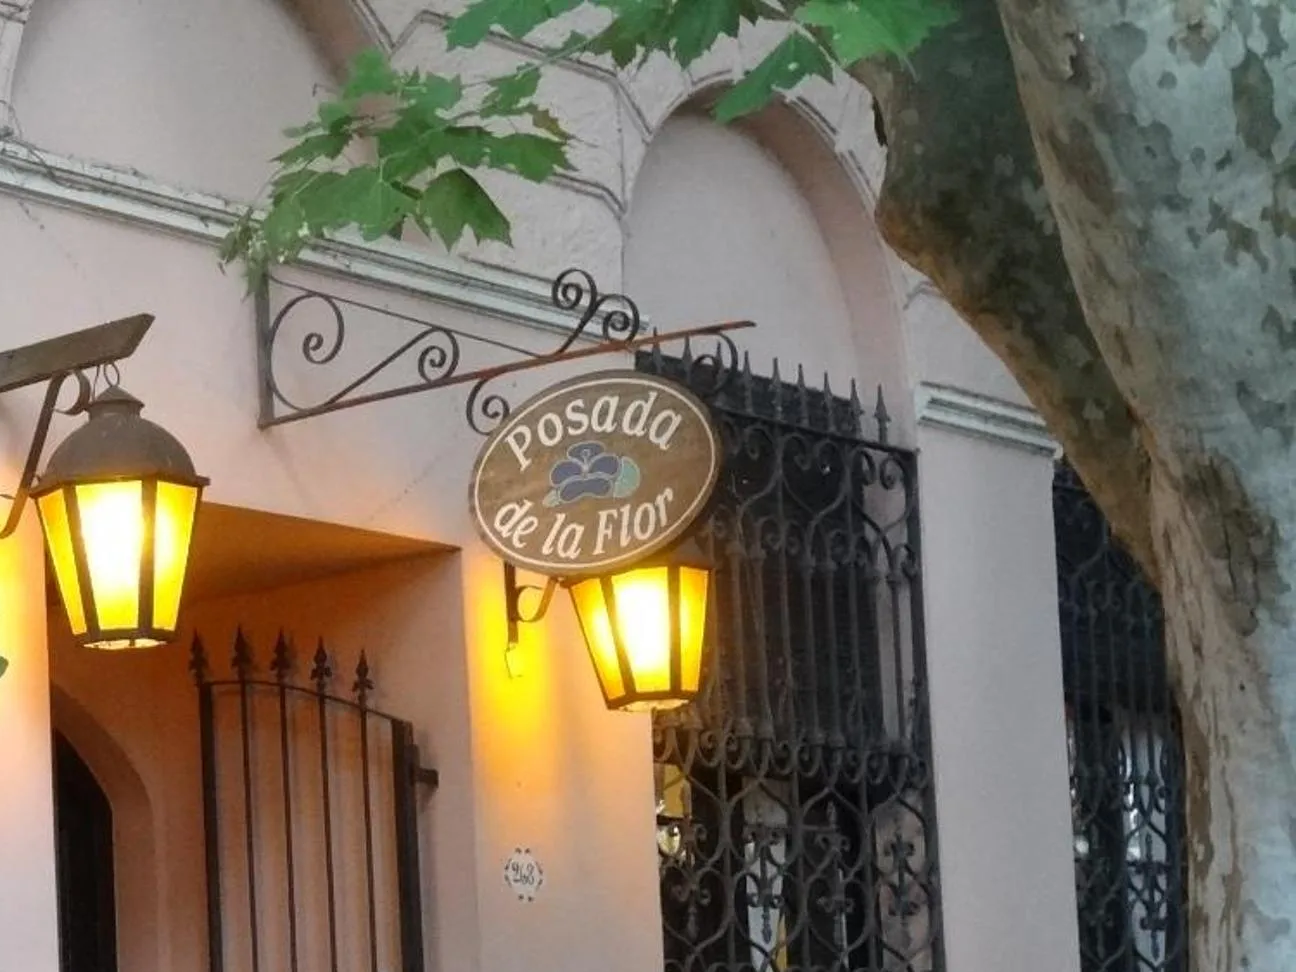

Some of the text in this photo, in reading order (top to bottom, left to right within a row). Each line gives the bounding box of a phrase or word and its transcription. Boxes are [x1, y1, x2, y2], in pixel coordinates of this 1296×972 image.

[504, 391, 682, 471] Posada
[492, 487, 674, 560] de la Flor
